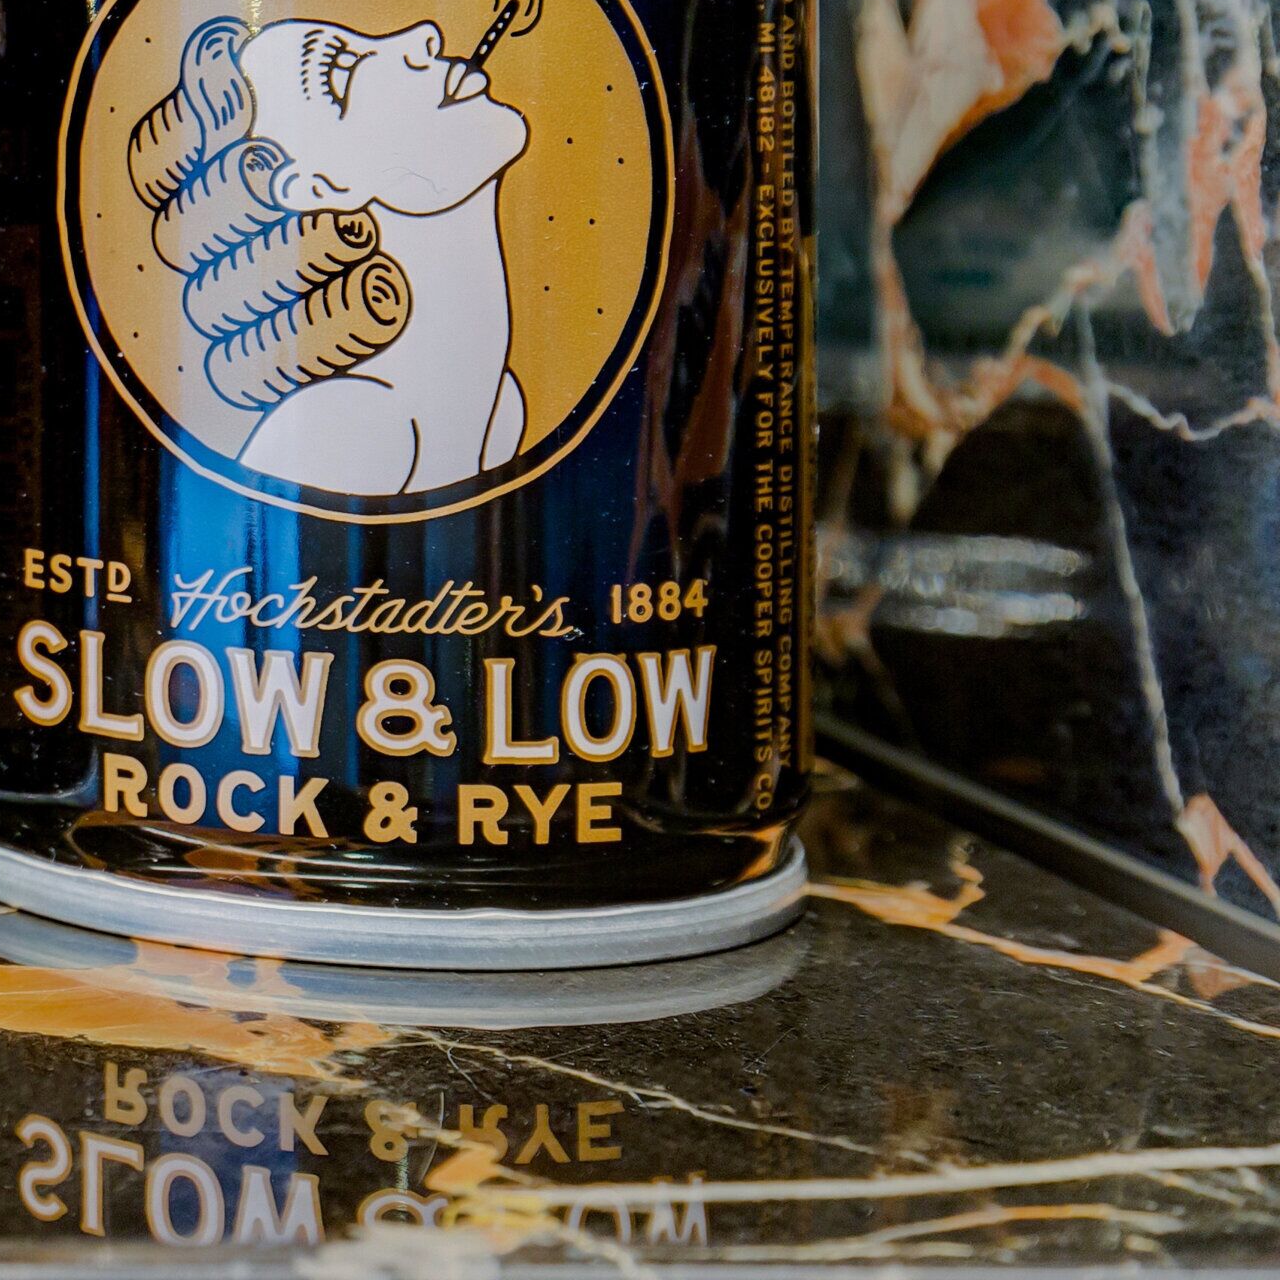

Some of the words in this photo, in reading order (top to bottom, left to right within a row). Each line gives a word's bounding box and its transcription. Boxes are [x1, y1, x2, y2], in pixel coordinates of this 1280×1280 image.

[757, 23, 775, 52] MI
[779, 14, 795, 70] AND
[757, 66, 775, 151] 48182
[779, 81, 795, 206] BOTTLED
[756, 185, 775, 377] EXCLUSIVELY
[779, 218, 794, 255] BY
[778, 267, 794, 455] TEMPERANCE
[756, 392, 774, 447] FOR
[755, 460, 774, 512] THE
[755, 524, 773, 637] COOPER
[778, 465, 793, 622] DISTILLING
[171, 567, 575, 639] Hochstadter's
[610, 581, 708, 624] 1884
[14, 619, 334, 758] SLOW
[356, 658, 457, 758] &
[483, 644, 717, 765] LOW
[755, 650, 773, 762] SPIRITS
[777, 635, 793, 768] COMPANY
[102, 751, 329, 839] ROCK
[367, 781, 418, 844] &
[457, 781, 624, 846] RYE
